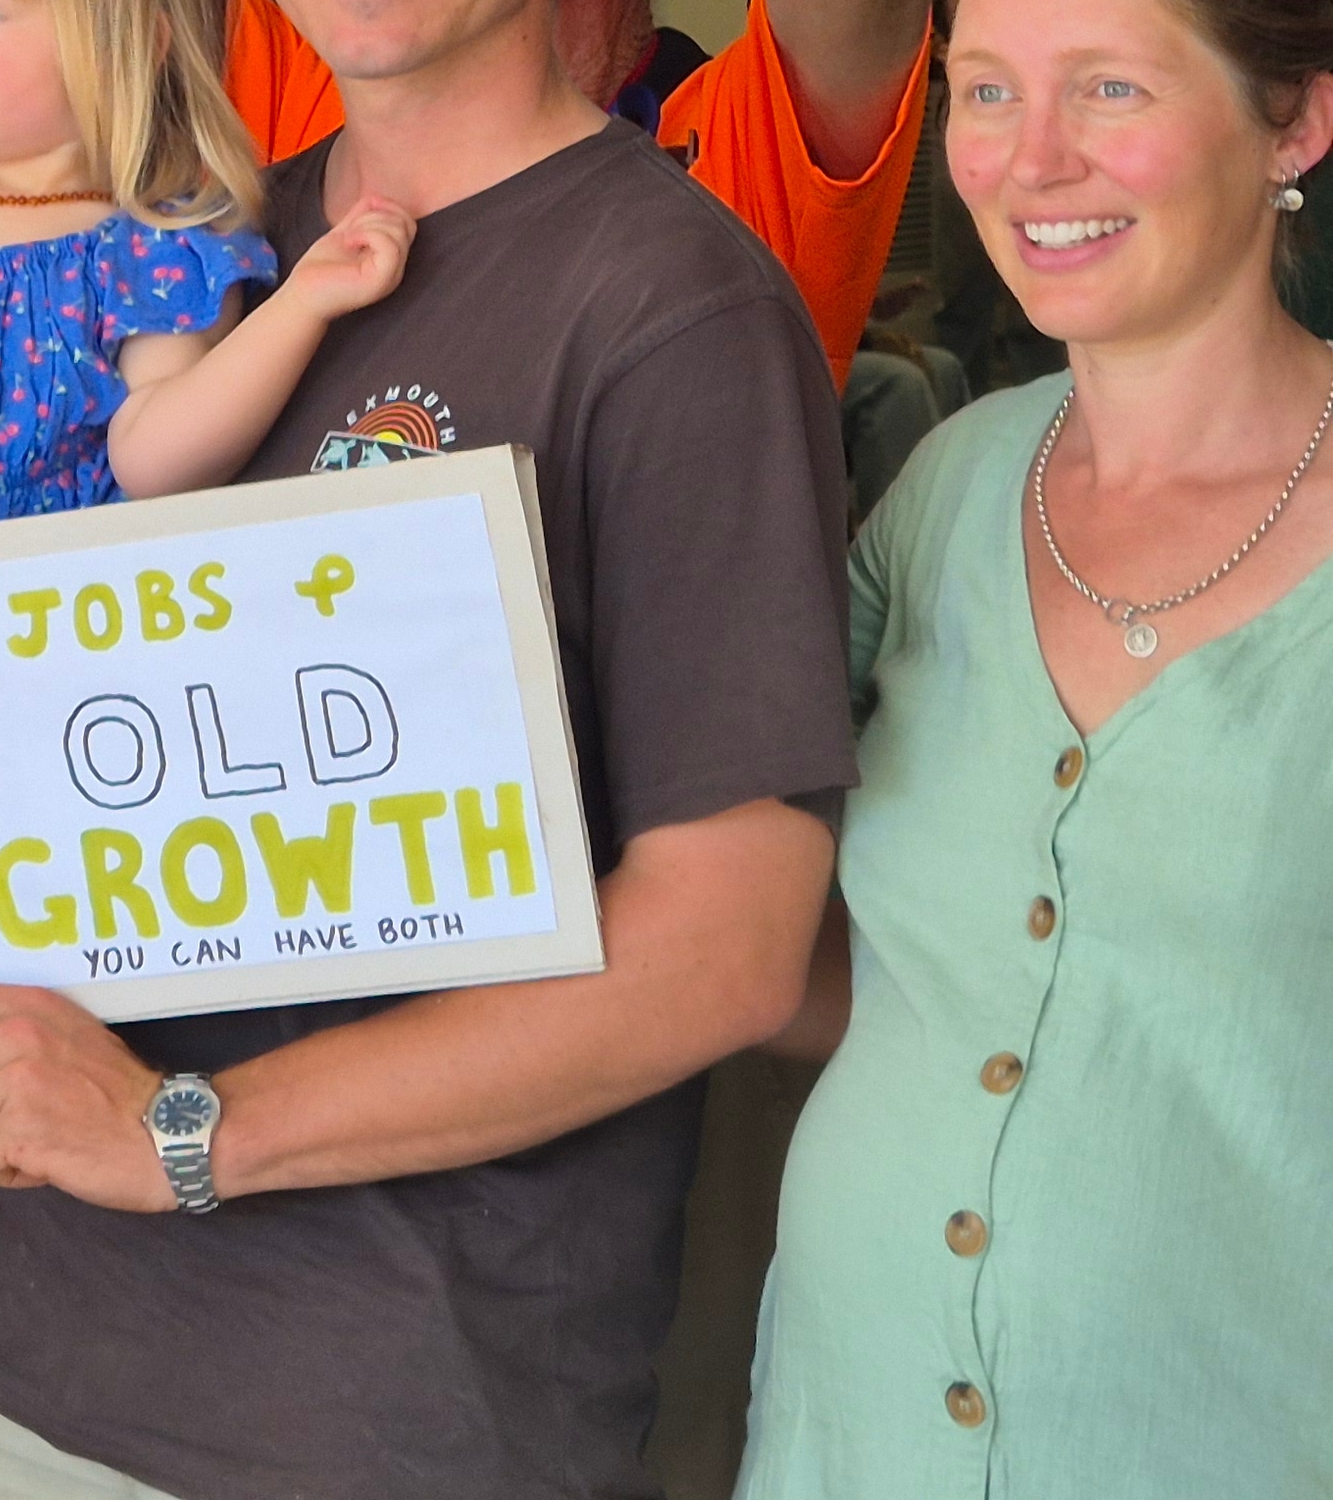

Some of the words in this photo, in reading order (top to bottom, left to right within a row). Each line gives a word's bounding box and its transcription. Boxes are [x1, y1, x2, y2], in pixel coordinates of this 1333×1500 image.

[6, 561, 233, 659] JOBS
[63, 663, 400, 811] OLD
[83, 946, 145, 978] YOU
[171, 936, 242, 967] CAN
[274, 922, 358, 956] HAVE
[378, 912, 465, 946] BOTH
